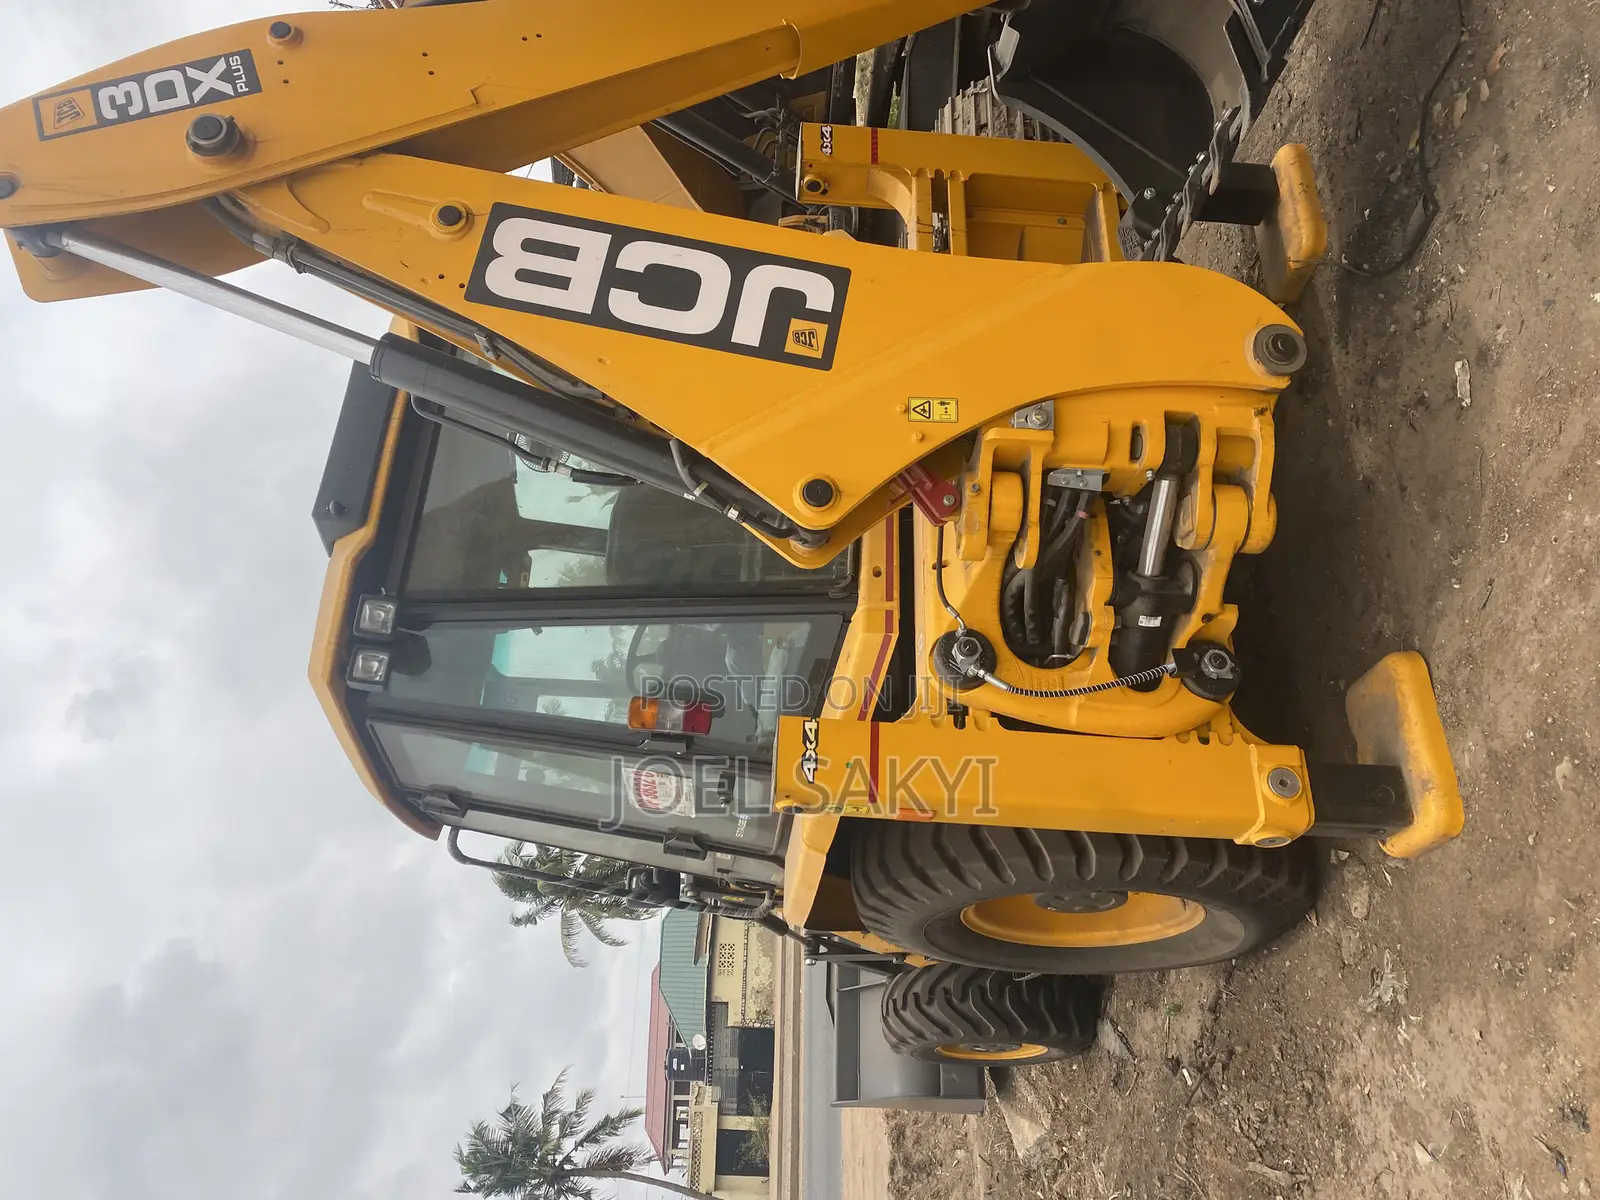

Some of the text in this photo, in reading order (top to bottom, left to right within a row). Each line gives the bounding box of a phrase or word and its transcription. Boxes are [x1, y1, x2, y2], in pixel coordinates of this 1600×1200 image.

[98, 56, 235, 120] 3DX
[229, 55, 250, 94] PLUS
[56, 99, 81, 124] JCB
[484, 217, 835, 348] JCB
[794, 330, 816, 348] JCB
[735, 819, 748, 838] STAGE
